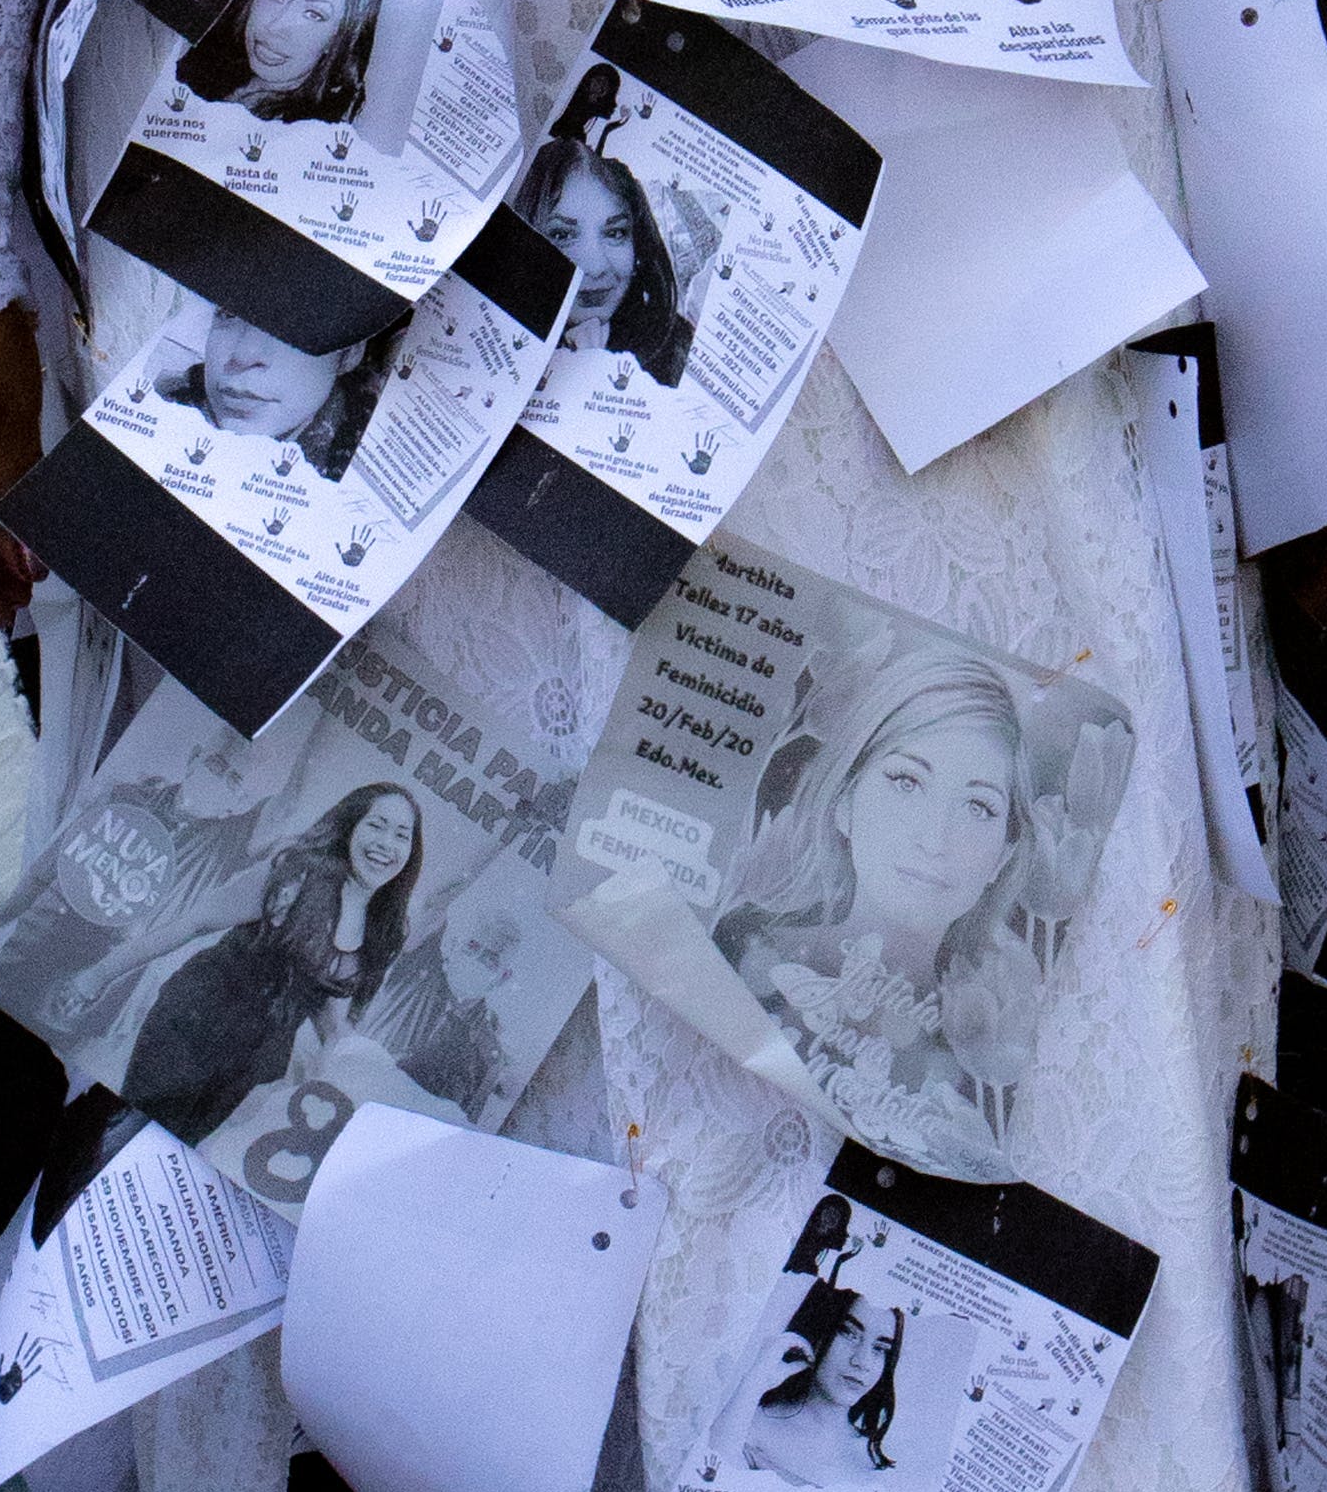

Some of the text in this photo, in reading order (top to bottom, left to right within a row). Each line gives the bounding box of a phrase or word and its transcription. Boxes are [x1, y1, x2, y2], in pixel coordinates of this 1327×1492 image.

[735, 603, 758, 626] 17
[756, 618, 805, 647] años
[655, 660, 765, 718] Feminicidio
[751, 656, 775, 679] de
[636, 696, 755, 757] 20/Feb/20
[635, 739, 724, 790] Edo.Mex.
[123, 1170, 179, 1326] DESAPARECIDA EL
[158, 1204, 190, 1279] ARANDA
[168, 1153, 227, 1311] PAULINA ROBLEDO
[108, 1199, 145, 1299] NOVIEMBRE
[139, 1304, 159, 1339] 2021
